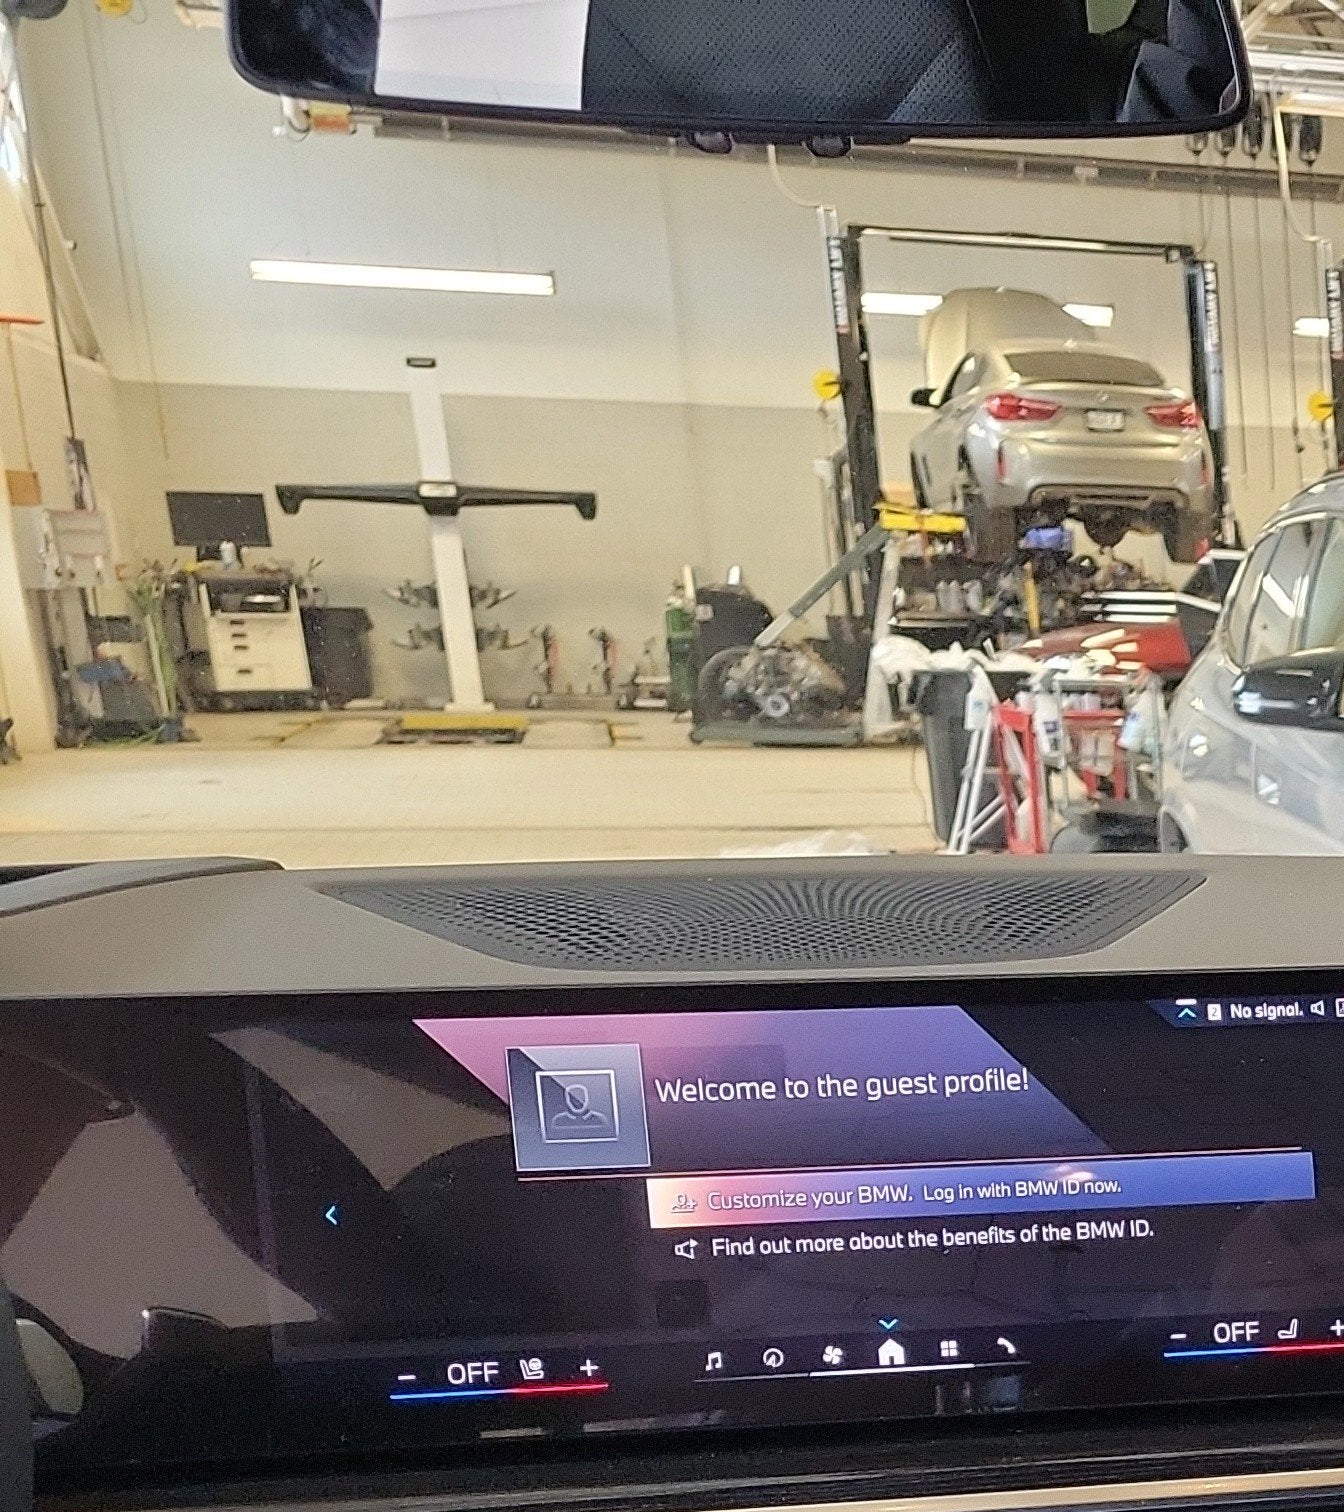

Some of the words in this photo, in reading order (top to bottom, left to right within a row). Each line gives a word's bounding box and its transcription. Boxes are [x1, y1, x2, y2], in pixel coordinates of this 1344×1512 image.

[1230, 1003, 1251, 1019] No
[1254, 1001, 1304, 1020] signal.
[654, 1078, 776, 1102] Welcome
[785, 1074, 809, 1099] to
[816, 1073, 858, 1098] the
[866, 1072, 937, 1101] guest
[945, 1067, 1030, 1098] profile!
[708, 1189, 807, 1210] Customize
[811, 1190, 853, 1209] your
[858, 1184, 912, 1204] BMW.
[924, 1184, 954, 1203] Log
[959, 1184, 973, 1199] in
[977, 1181, 1011, 1199] with
[1015, 1181, 1058, 1197] BMW
[1062, 1180, 1080, 1195] ID
[1084, 1180, 1122, 1194] now.
[712, 1237, 754, 1257] Find
[760, 1236, 792, 1256] out
[795, 1236, 845, 1253] more
[849, 1231, 904, 1251] about
[907, 1230, 938, 1248] the
[943, 1226, 1016, 1246] benefits
[1020, 1224, 1039, 1243] of
[1042, 1223, 1072, 1241] the
[1076, 1220, 1125, 1240] BMW
[1130, 1219, 1154, 1237] ID.
[1213, 1321, 1260, 1343] OFF
[447, 1361, 499, 1385] OFF
